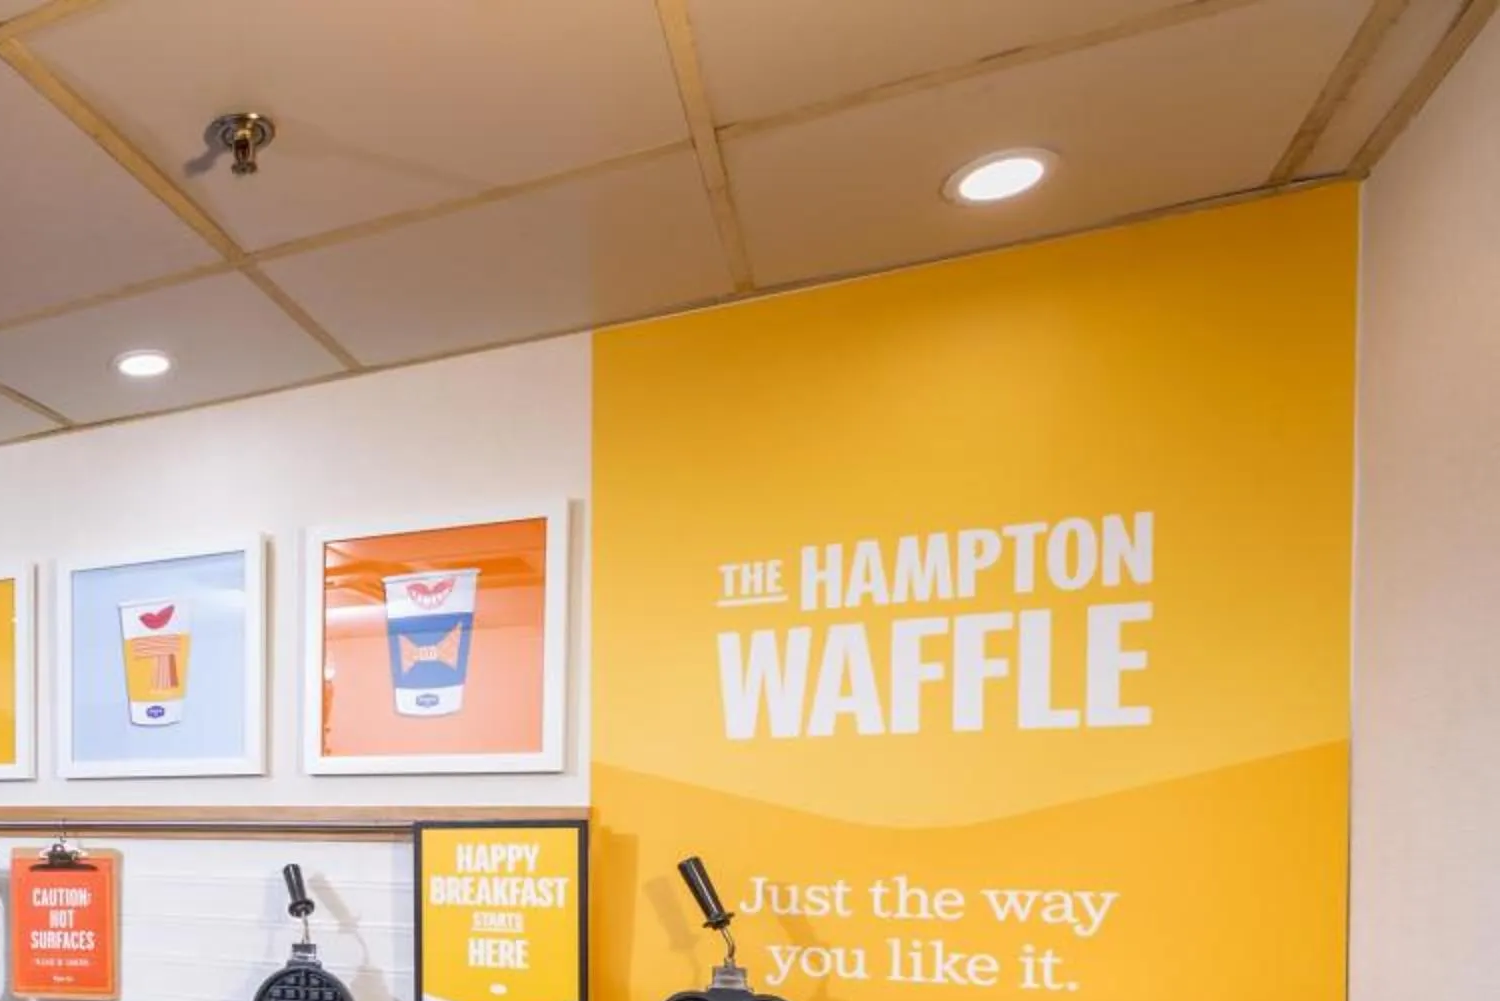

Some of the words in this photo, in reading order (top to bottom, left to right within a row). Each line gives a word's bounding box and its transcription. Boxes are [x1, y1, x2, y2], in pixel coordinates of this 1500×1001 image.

[716, 559, 788, 608] THE
[800, 510, 1155, 612] HAMPTON
[716, 600, 1154, 740] WAFFLE
[455, 842, 541, 874] HAPPY
[32, 887, 92, 908] CAUTION:
[429, 875, 570, 908] BREAKFAST
[739, 876, 852, 916] Just
[868, 875, 965, 921] the
[981, 888, 1121, 938] way
[49, 909, 75, 929] HOT
[30, 930, 96, 950] SURFACES
[467, 937, 530, 970] HERE
[764, 943, 869, 986] you
[887, 938, 999, 987] like
[1019, 944, 1080, 993] it.
